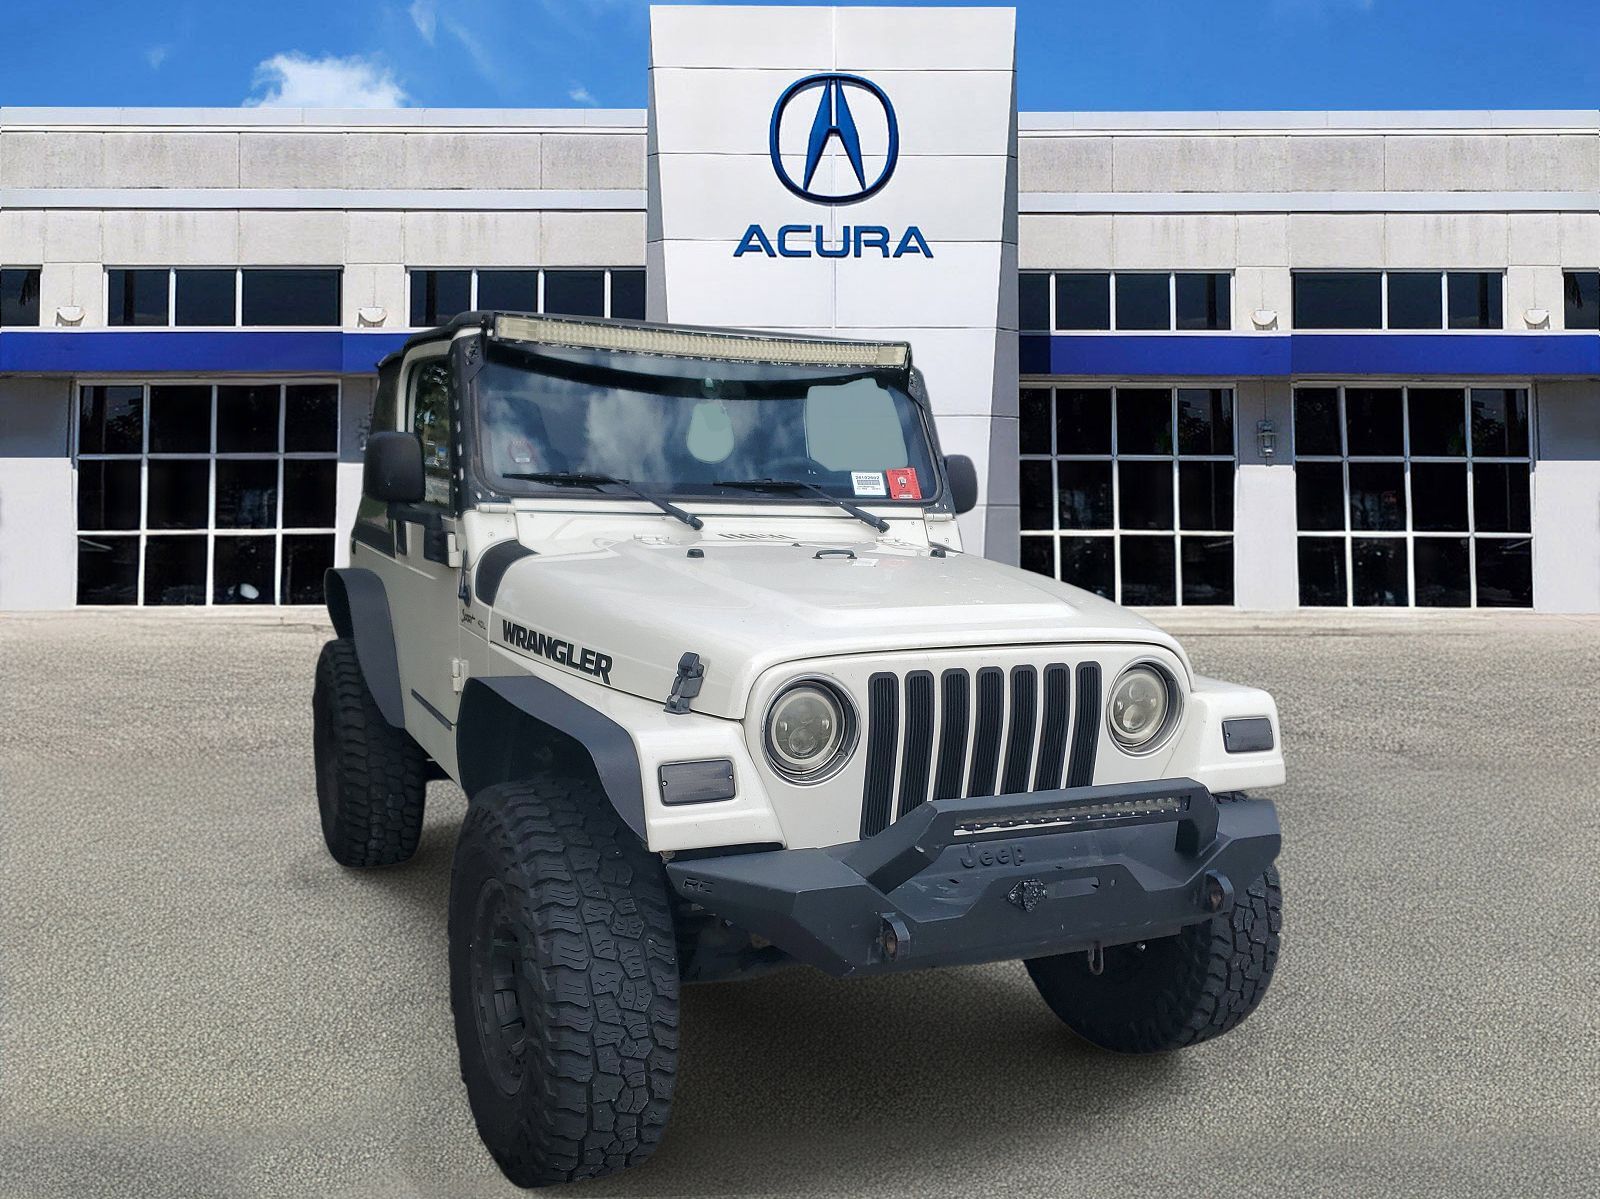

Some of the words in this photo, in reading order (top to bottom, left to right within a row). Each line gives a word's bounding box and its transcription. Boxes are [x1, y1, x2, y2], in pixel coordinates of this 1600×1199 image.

[733, 224, 934, 258] ACURA
[502, 619, 613, 686] WRANGLER
[960, 842, 1025, 869] Jeep
